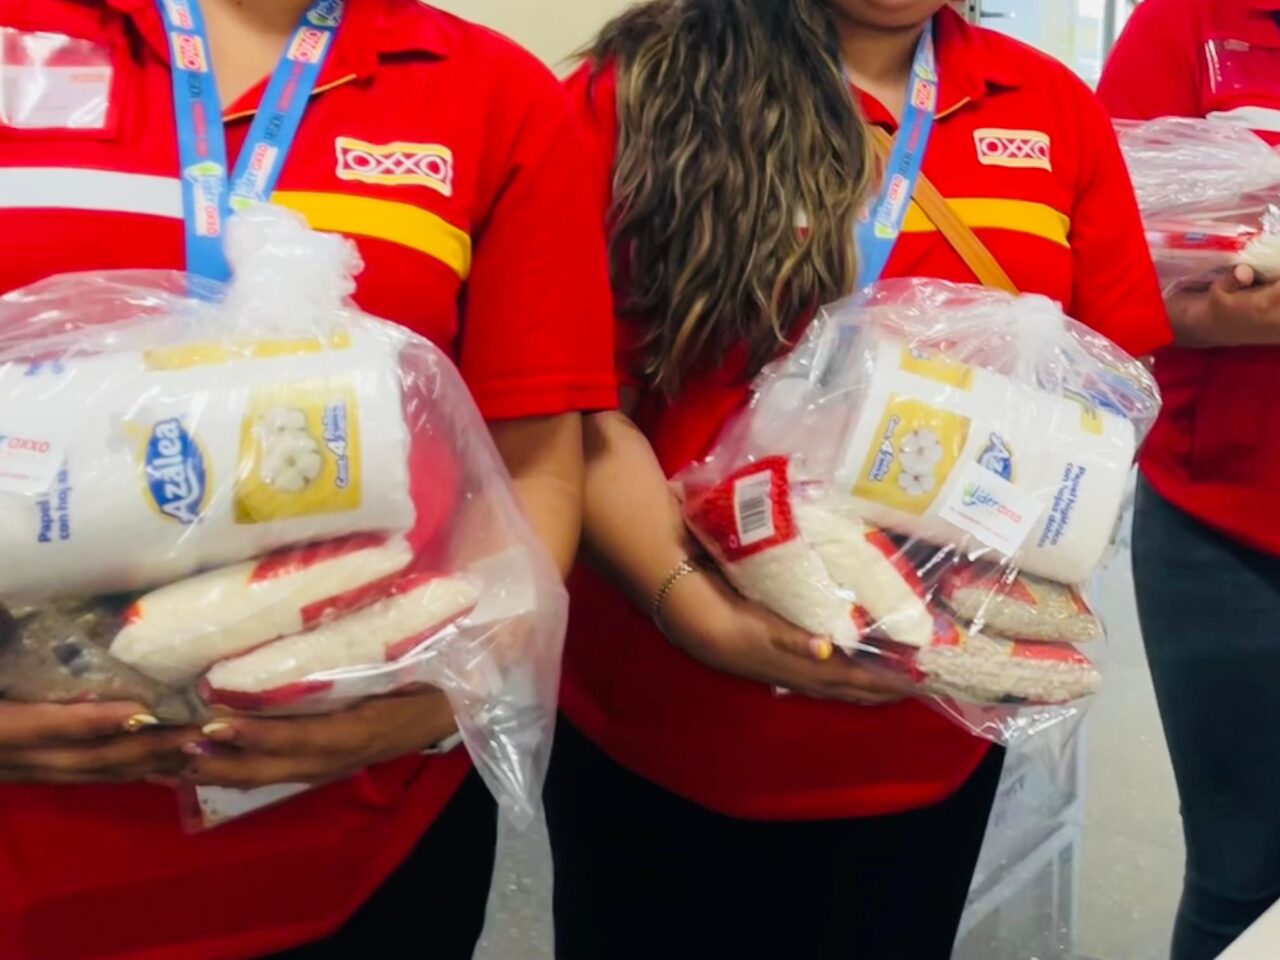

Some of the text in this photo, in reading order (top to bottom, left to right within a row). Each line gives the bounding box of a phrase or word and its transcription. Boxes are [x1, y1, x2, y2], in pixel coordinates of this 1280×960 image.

[981, 138, 1049, 161] OXXO
[346, 150, 446, 180] OXXO
[7, 437, 50, 454] OXXO
[148, 417, 203, 525] Azálea
[37, 499, 53, 542] Papel
[58, 512, 71, 541] con
